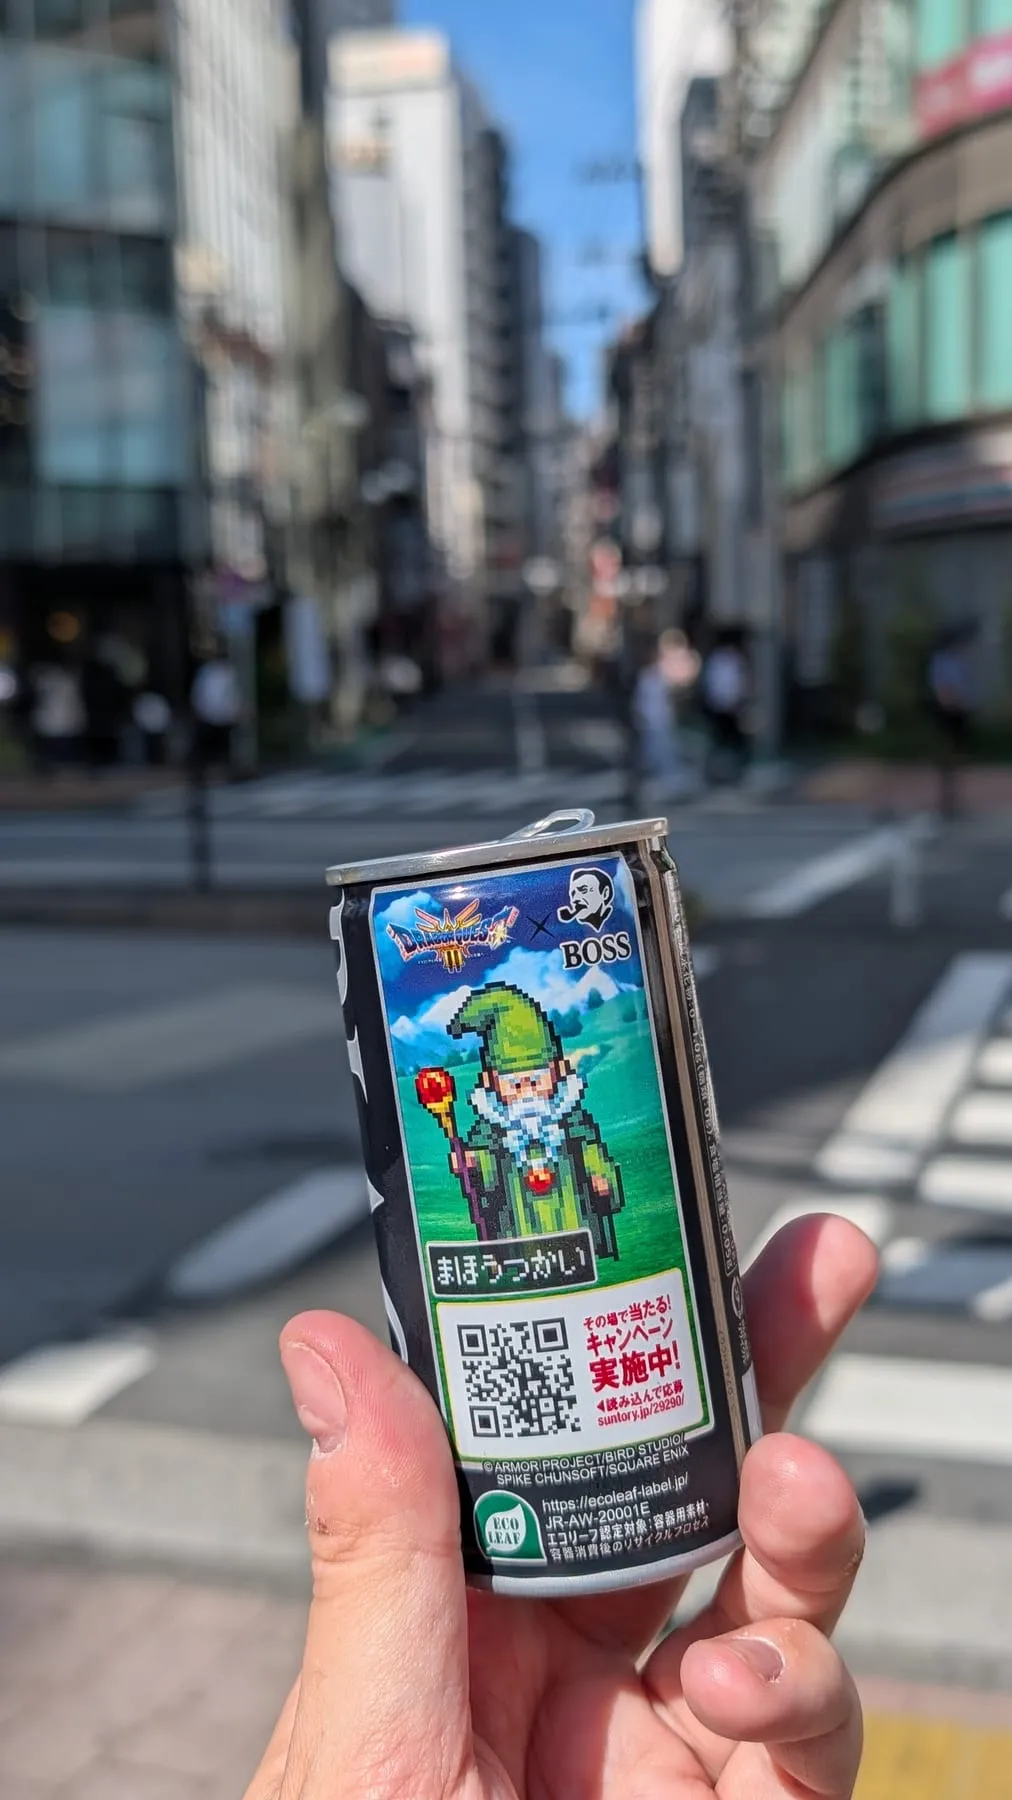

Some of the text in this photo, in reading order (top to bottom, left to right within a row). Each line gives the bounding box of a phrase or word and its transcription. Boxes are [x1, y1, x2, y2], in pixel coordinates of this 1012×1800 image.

[561, 932, 632, 969] BOSS
[437, 1246, 586, 1286] まほうつかい
[583, 1293, 672, 1331] その場で当たる!
[586, 1317, 673, 1357] キャンペーン
[589, 1340, 681, 1393] 実施中!
[597, 1393, 685, 1426] suntory.jp/29290/
[497, 1444, 690, 1486] SPIKE CHUNSOFT/SQUARE ENIX
[542, 1447, 635, 1470] PROJECT/BIRD
[638, 1432, 685, 1455] STUDIO/
[542, 1472, 689, 1513] https://ecoleaf-label.jp/
[492, 1515, 520, 1530] ECO
[545, 1501, 651, 1529] JR-AW-20001E
[488, 1531, 521, 1545] LEAF
[550, 1515, 710, 1560] 容器消費後のリサイクルプロセス
